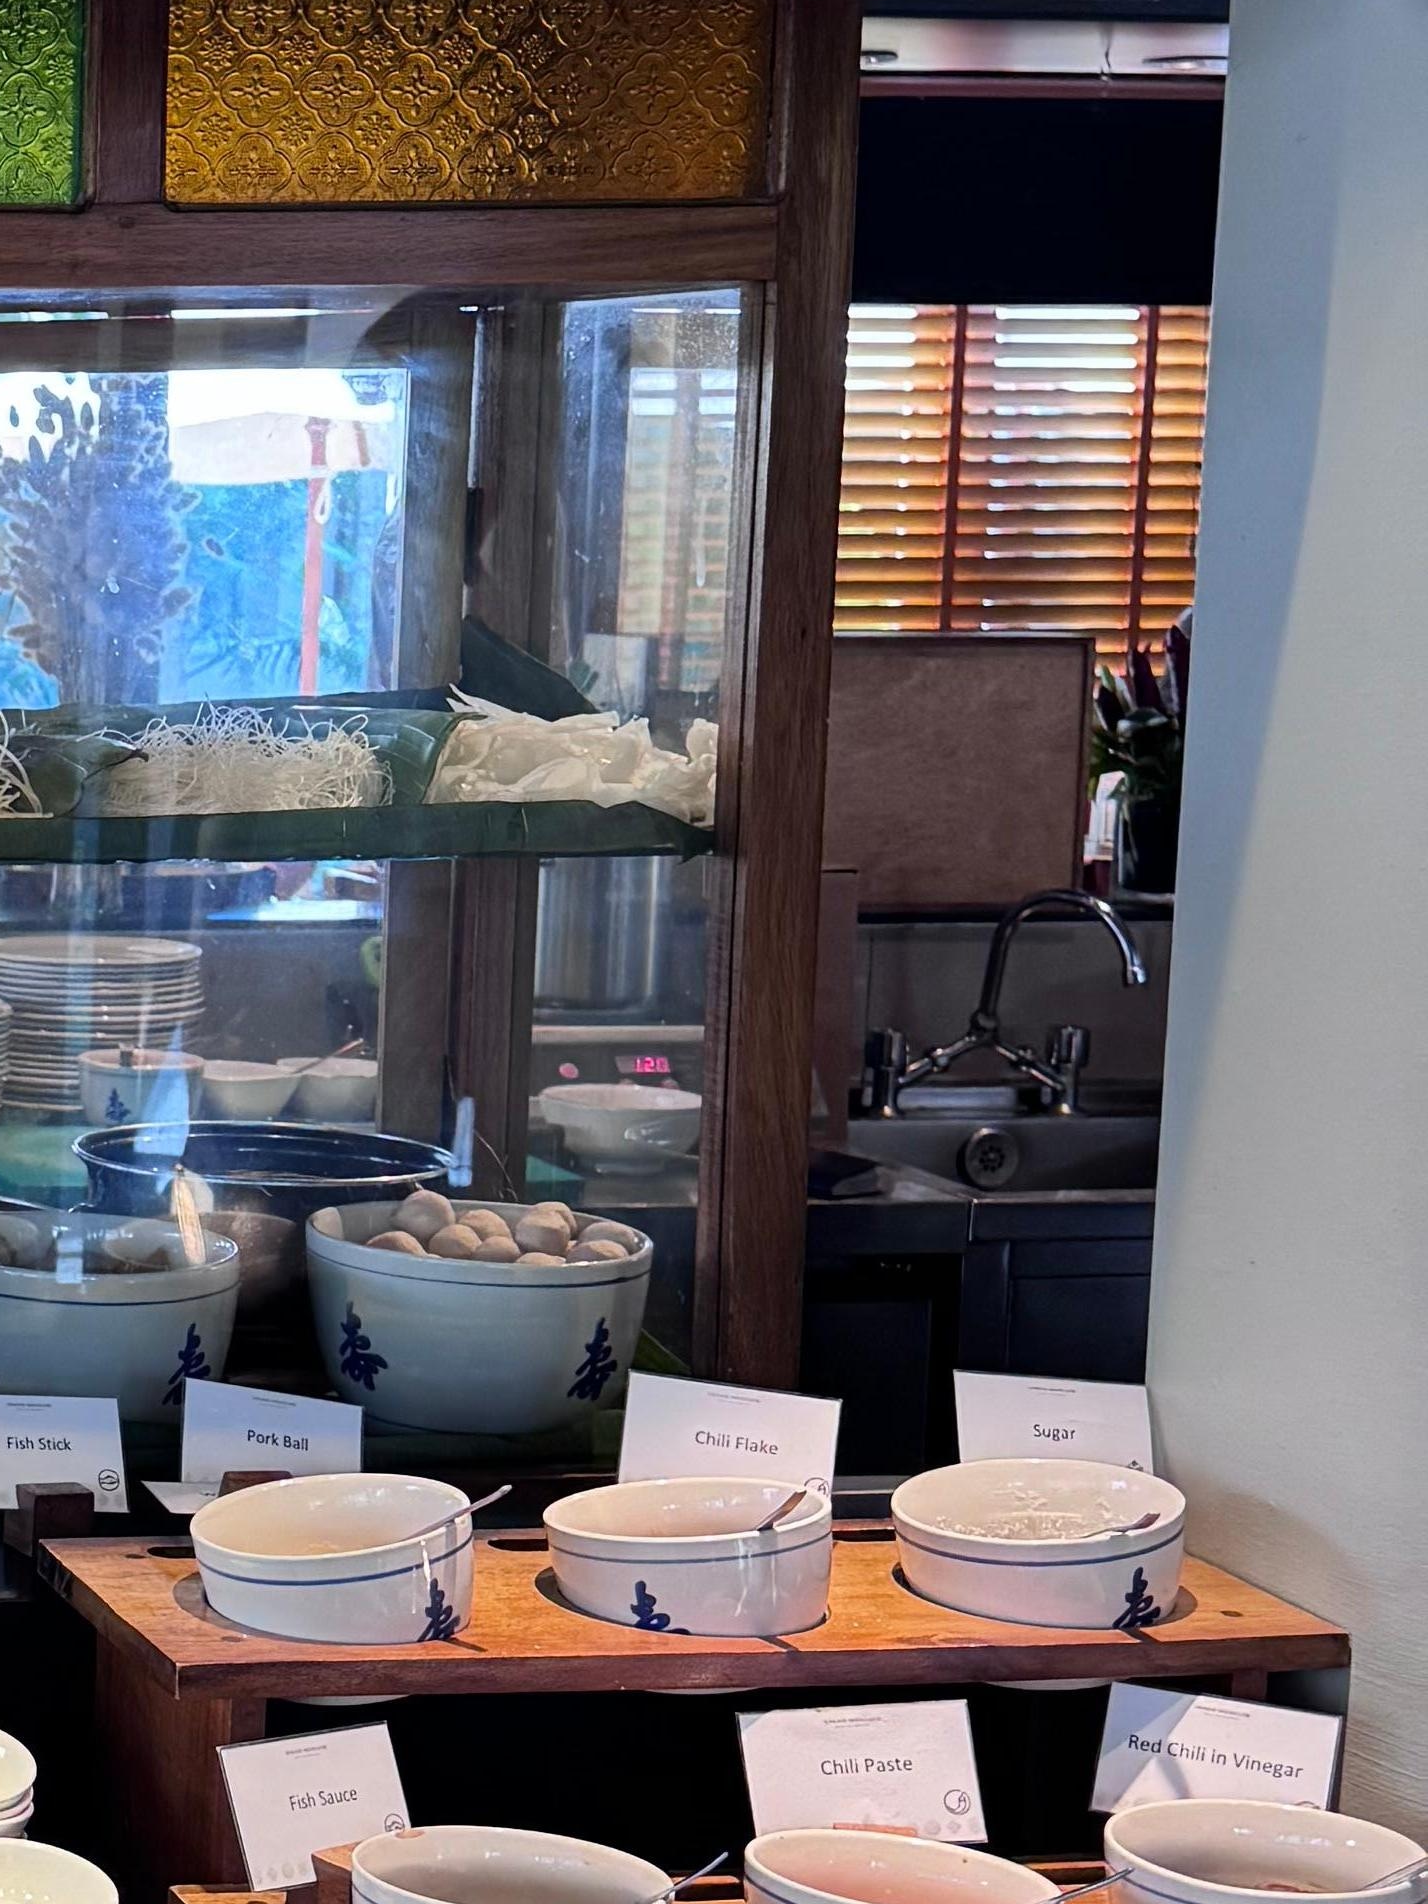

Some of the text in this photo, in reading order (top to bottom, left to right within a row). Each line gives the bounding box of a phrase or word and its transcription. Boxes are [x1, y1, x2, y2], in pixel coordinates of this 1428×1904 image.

[7, 1436, 72, 1451] Fish Stick
[247, 1429, 309, 1451] Pork Ball
[694, 1430, 779, 1455] Chili Flake
[1033, 1424, 1076, 1441] Sugar
[821, 1757, 913, 1776] Chili Paste
[1127, 1734, 1304, 1779] Red Chili in Vinegar
[289, 1789, 358, 1811] Fish Sauce
